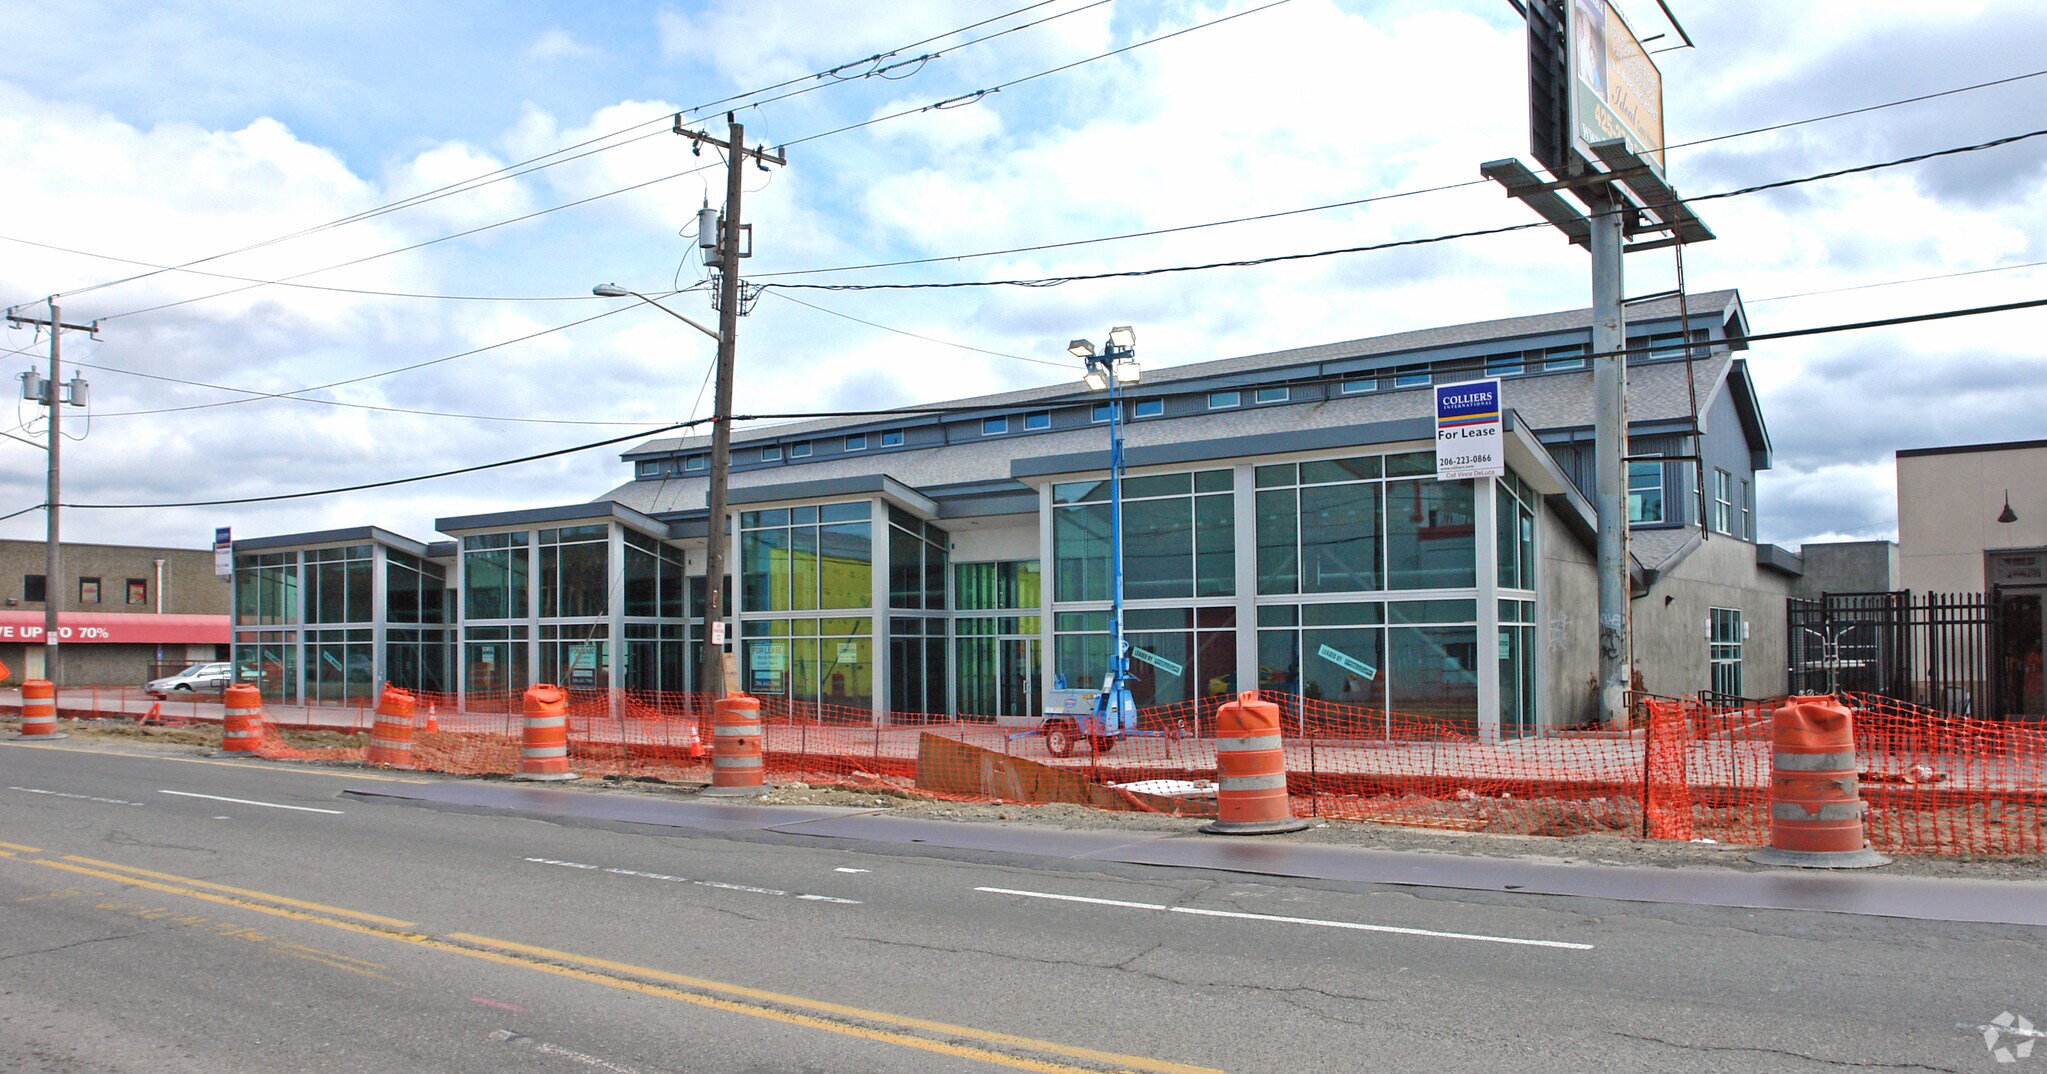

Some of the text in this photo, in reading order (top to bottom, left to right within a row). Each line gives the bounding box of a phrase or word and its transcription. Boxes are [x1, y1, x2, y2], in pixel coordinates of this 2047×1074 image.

[1443, 392, 1492, 405] COLLIERS
[1444, 401, 1492, 410] INTERNATIONAL
[1438, 428, 1496, 441] For Lease
[1440, 455, 1491, 466] 206-223-0866
[20, 626, 43, 638] UP
[78, 627, 109, 639] 70%
[752, 646, 783, 654] FOR LEASE
